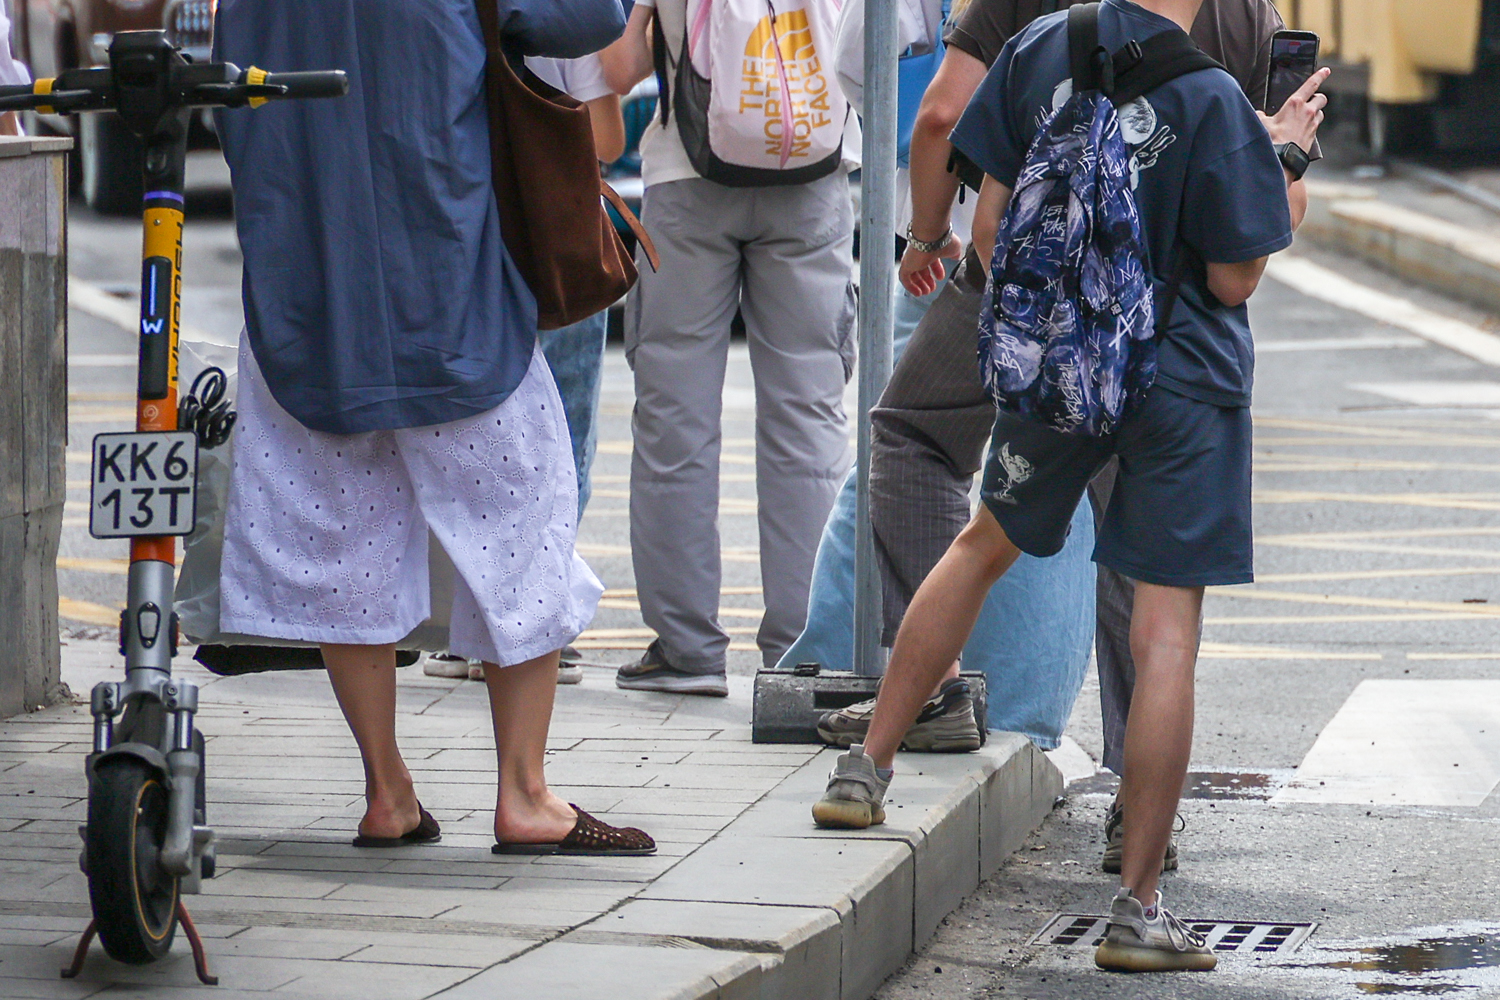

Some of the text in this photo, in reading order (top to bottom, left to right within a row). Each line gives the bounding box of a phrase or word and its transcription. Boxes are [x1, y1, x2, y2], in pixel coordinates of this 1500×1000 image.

[739, 59, 764, 113] THE
[801, 56, 831, 129] FACE
[101, 487, 190, 529] 13T
